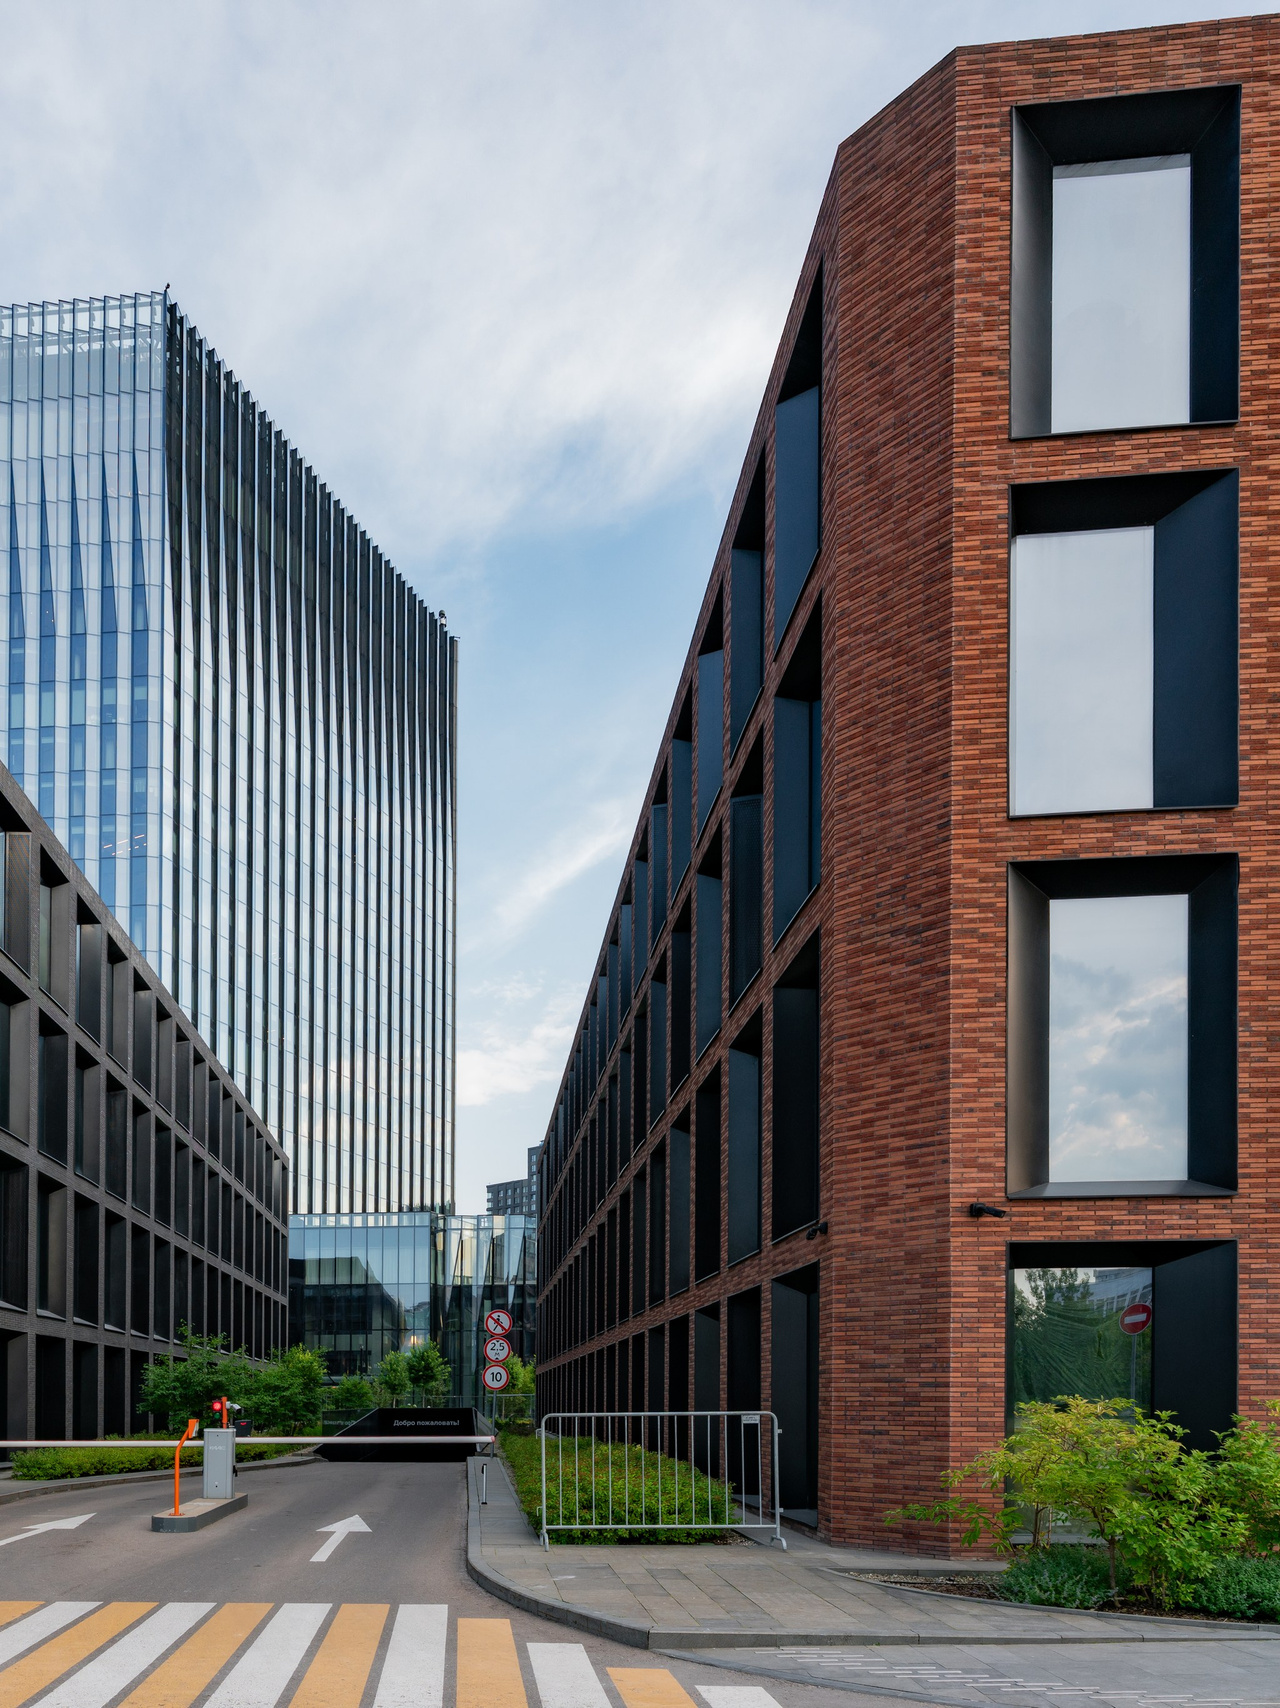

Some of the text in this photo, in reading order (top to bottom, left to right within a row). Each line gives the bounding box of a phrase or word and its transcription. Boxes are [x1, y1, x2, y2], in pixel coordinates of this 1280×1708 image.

[490, 1342, 505, 1352] 2,5
[490, 1371, 502, 1382] 10
[393, 1419, 460, 1427] Добро пожаловать!
